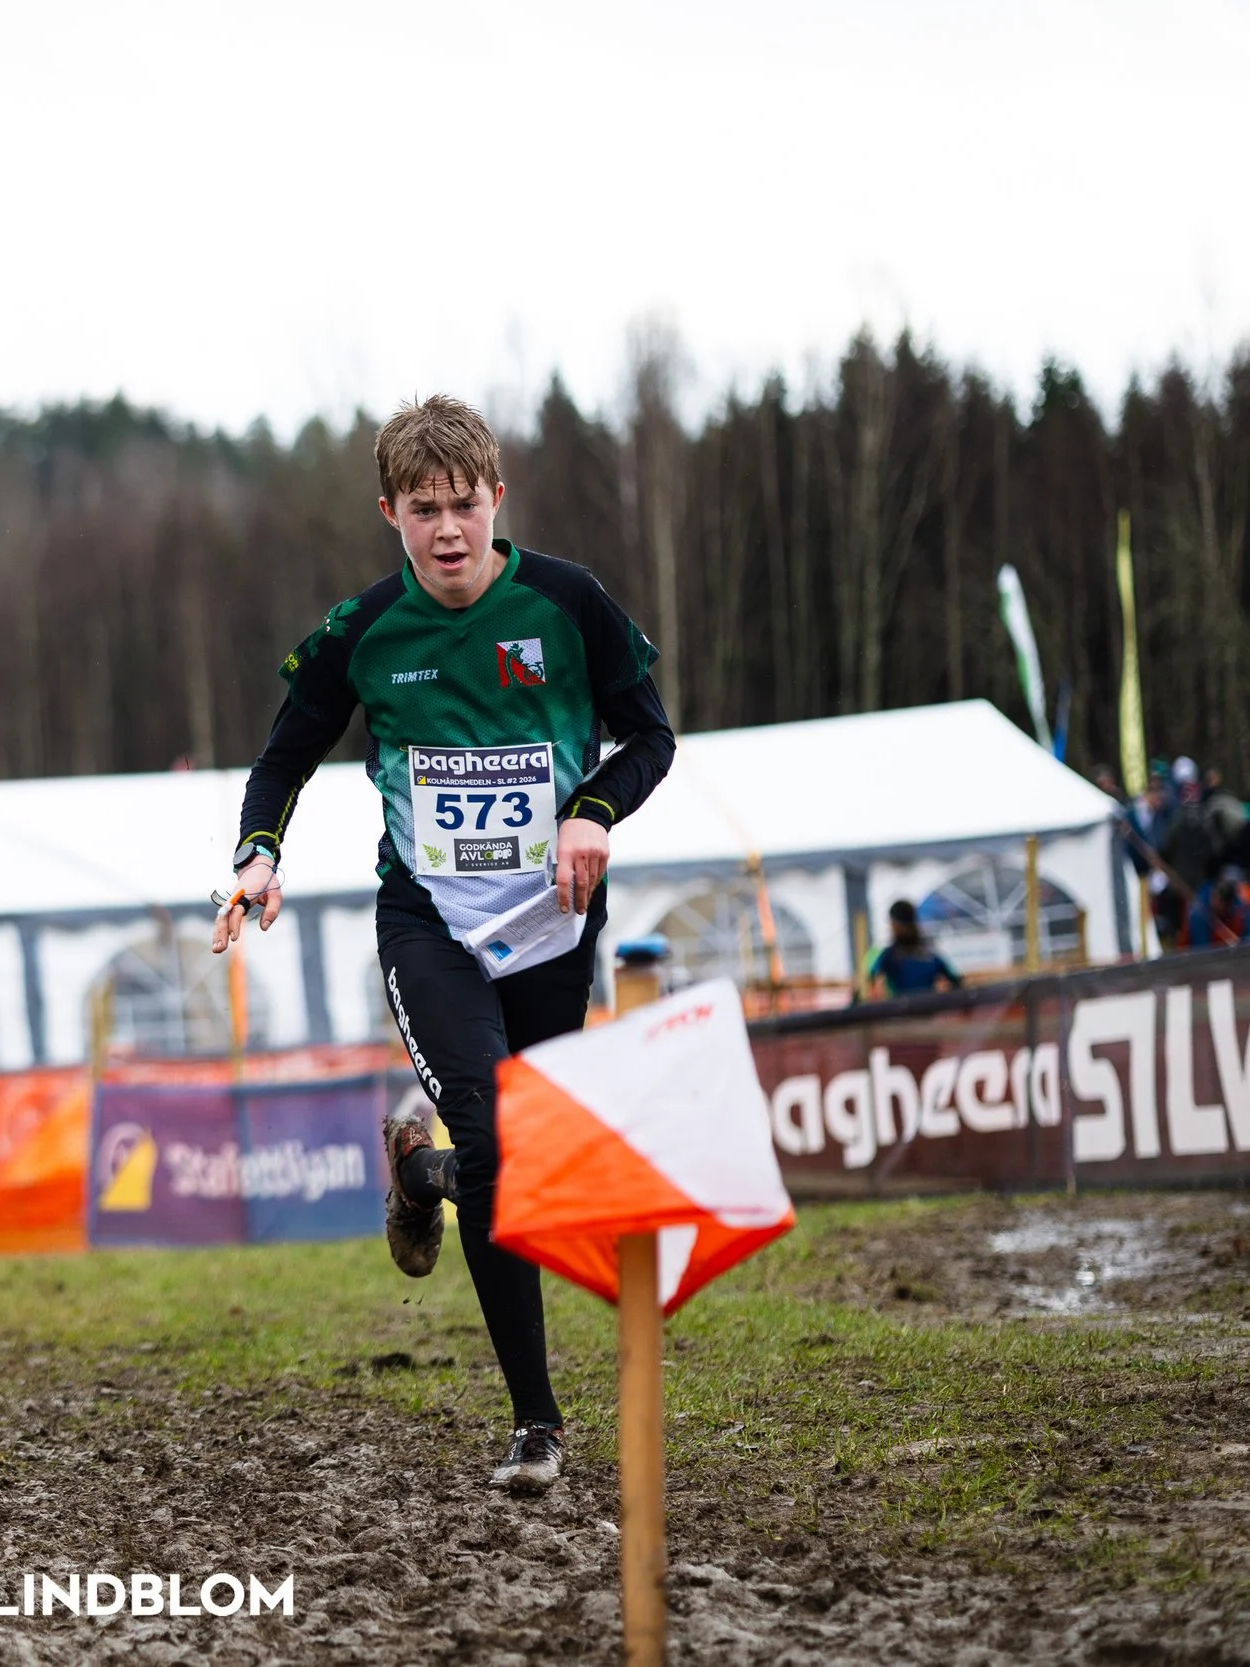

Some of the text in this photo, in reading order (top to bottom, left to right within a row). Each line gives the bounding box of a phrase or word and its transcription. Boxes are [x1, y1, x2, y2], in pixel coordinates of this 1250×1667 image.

[391, 669, 439, 684] TRIMTEX
[413, 751, 549, 776] bagheera
[426, 775, 491, 786] KOLMÅRDSMEDELN
[507, 777, 518, 785] #2
[519, 775, 537, 784] 2026
[435, 791, 533, 831] 573
[459, 841, 513, 852] GODKÄNDA
[459, 848, 513, 861] AVLOPP
[387, 966, 443, 1100] bagheera
[763, 1044, 1062, 1170] agheera
